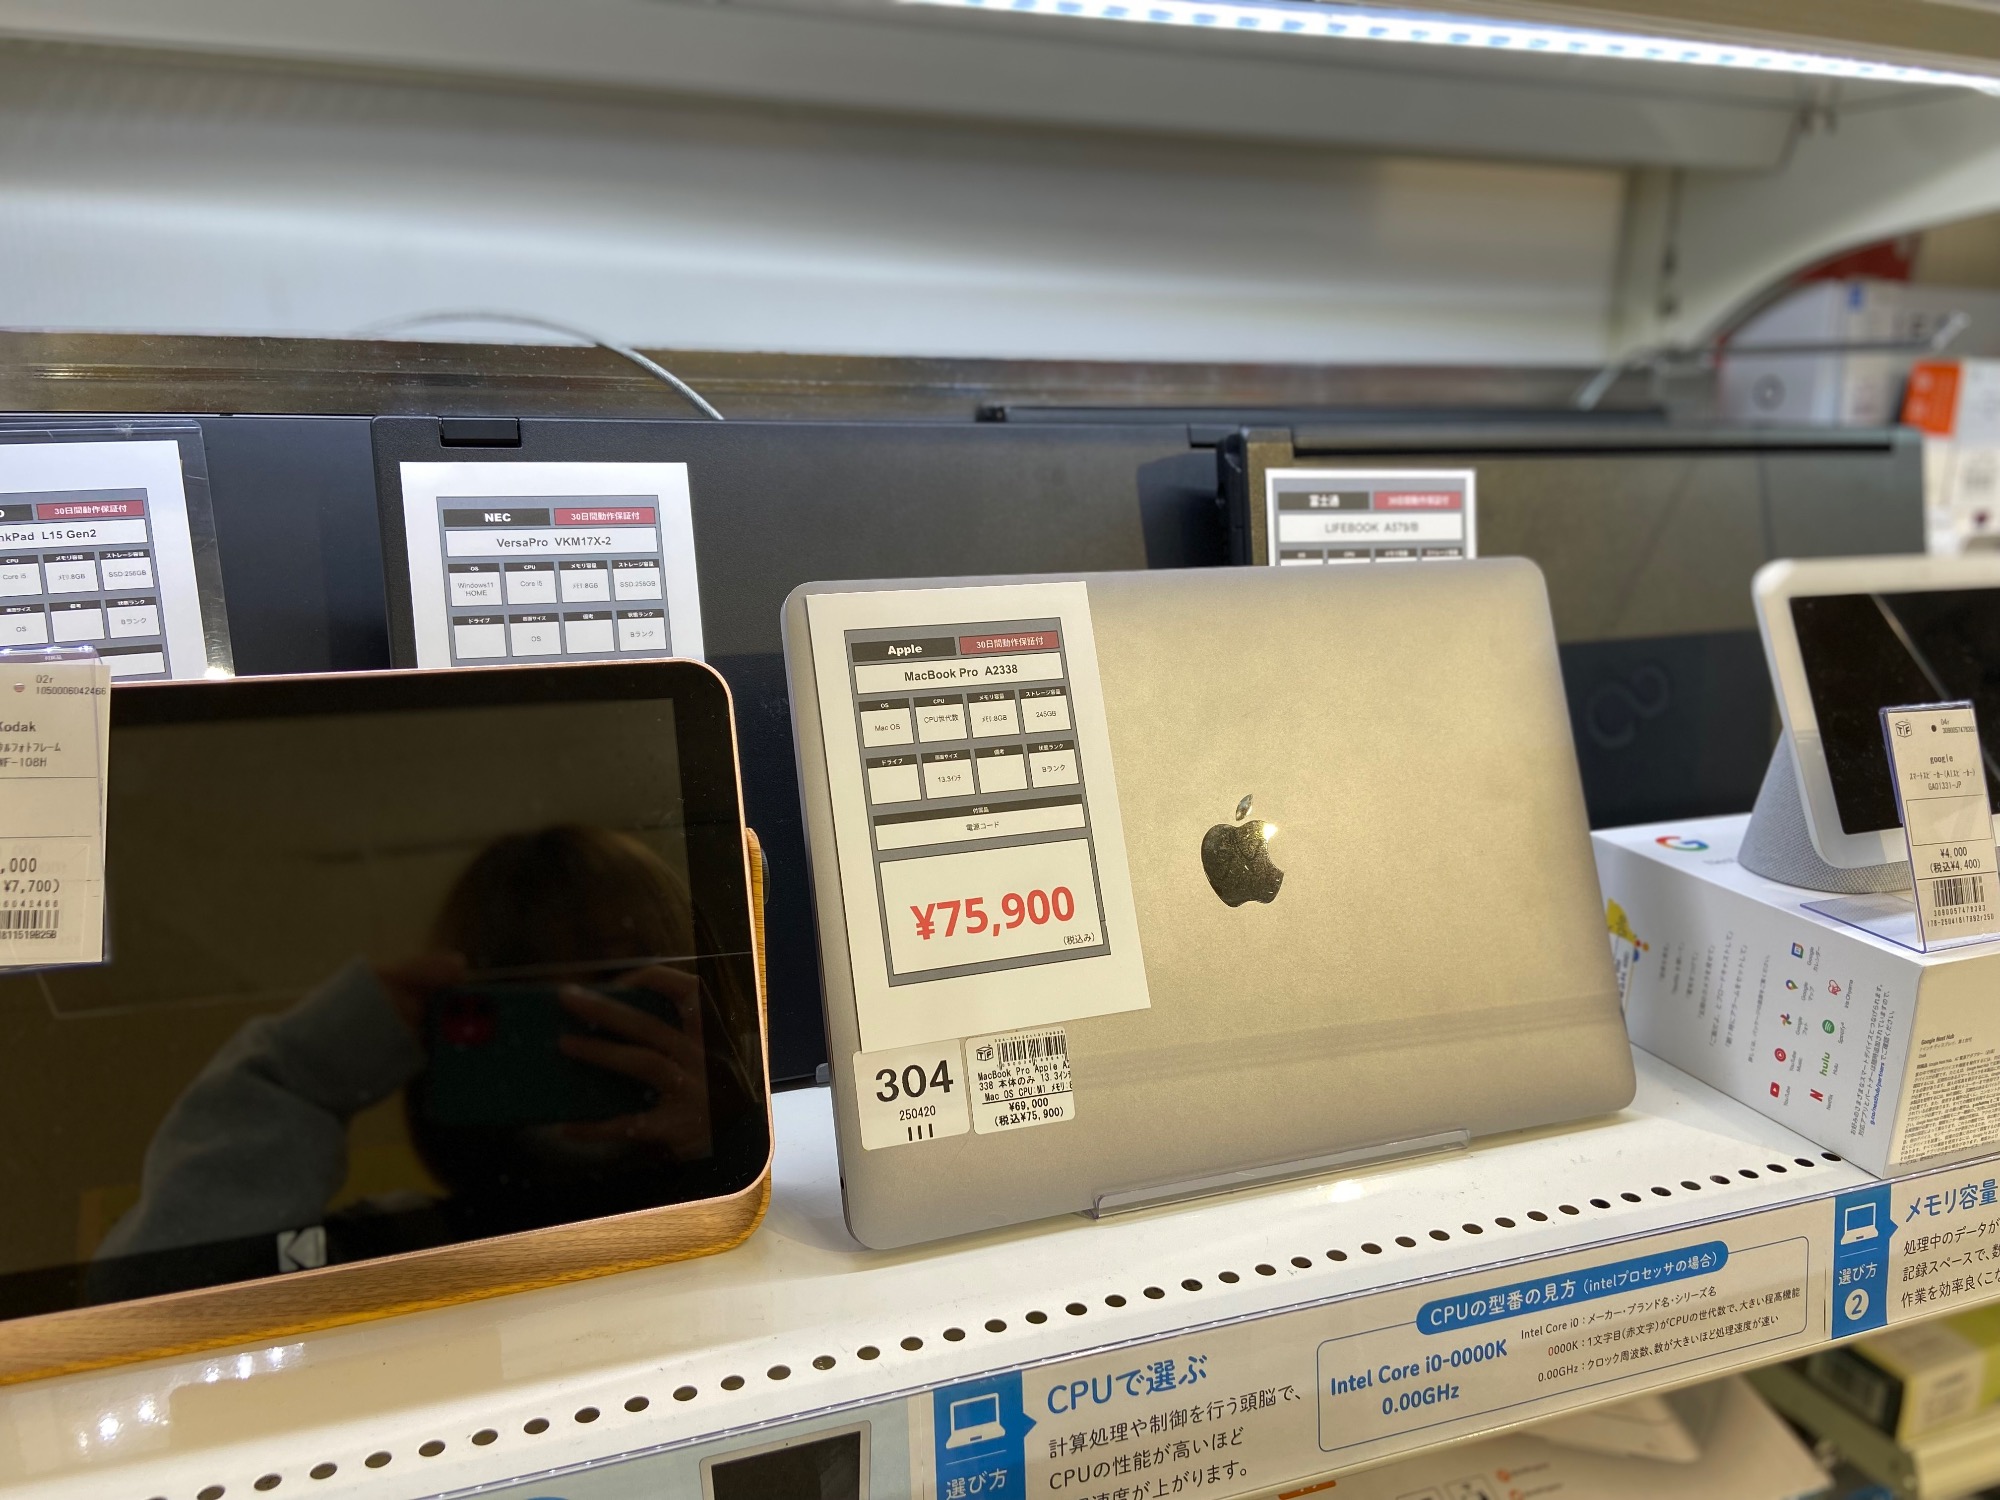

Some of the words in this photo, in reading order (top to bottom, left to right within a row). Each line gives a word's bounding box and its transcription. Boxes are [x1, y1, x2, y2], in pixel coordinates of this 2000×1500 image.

[54, 505, 127, 515] 30日間動作保証付
[484, 512, 512, 523] NEC
[571, 511, 640, 522] 30日間動作保証付
[42, 530, 63, 540] L15
[66, 529, 97, 539] Gen2
[496, 537, 548, 548] VersaPro
[554, 536, 612, 548] VKM17X-2
[888, 644, 923, 657] Apple
[976, 636, 1044, 649] 30日間動作保証付
[904, 668, 956, 682] MacBook
[959, 668, 978, 678] Pro
[984, 664, 1018, 676] A2338
[1930, 754, 1954, 764] google
[966, 821, 1000, 832] 電源コード
[1940, 846, 1968, 858] ¥4,000
[910, 886, 1075, 940] ¥75,900
[1063, 932, 1095, 946] (税込み)
[978, 1068, 1012, 1081] MacBook
[1016, 1066, 1030, 1076] Pro
[1034, 1064, 1058, 1074] Apple
[1819, 1052, 1830, 1076] hulu
[876, 1060, 954, 1102] 304
[978, 1080, 994, 1091] 338
[998, 1076, 1036, 1088] 本体のみ
[984, 1092, 1000, 1102] Mac
[1003, 1089, 1014, 1098] OS
[1008, 1096, 1050, 1112] ¥69,000
[899, 1105, 936, 1122] 250420
[994, 1106, 1064, 1128] (税込¥75,900)
[1905, 1178, 1998, 1223] メモリ容量
[1904, 1218, 2000, 1257] 処理中のデータが
[1838, 1262, 1878, 1286] 選び方
[1430, 1280, 1576, 1326] CPUの型番の見方
[1851, 1294, 1863, 1315] 2
[1520, 1326, 1544, 1340] Intel
[1546, 1320, 1568, 1334] Core
[1330, 1368, 1373, 1396] Intel
[1378, 1365, 1420, 1384] Core
[1425, 1338, 1508, 1374] i0-0000K
[1047, 1354, 1208, 1414] CPUで選ぶ
[1382, 1382, 1460, 1416] 0.00GHz
[1048, 1384, 1301, 1459] 計算処理や制御を行う頭脳で、
[1050, 1426, 1244, 1490] CPUの性能が高いほど
[945, 1468, 1008, 1500] 選び方
